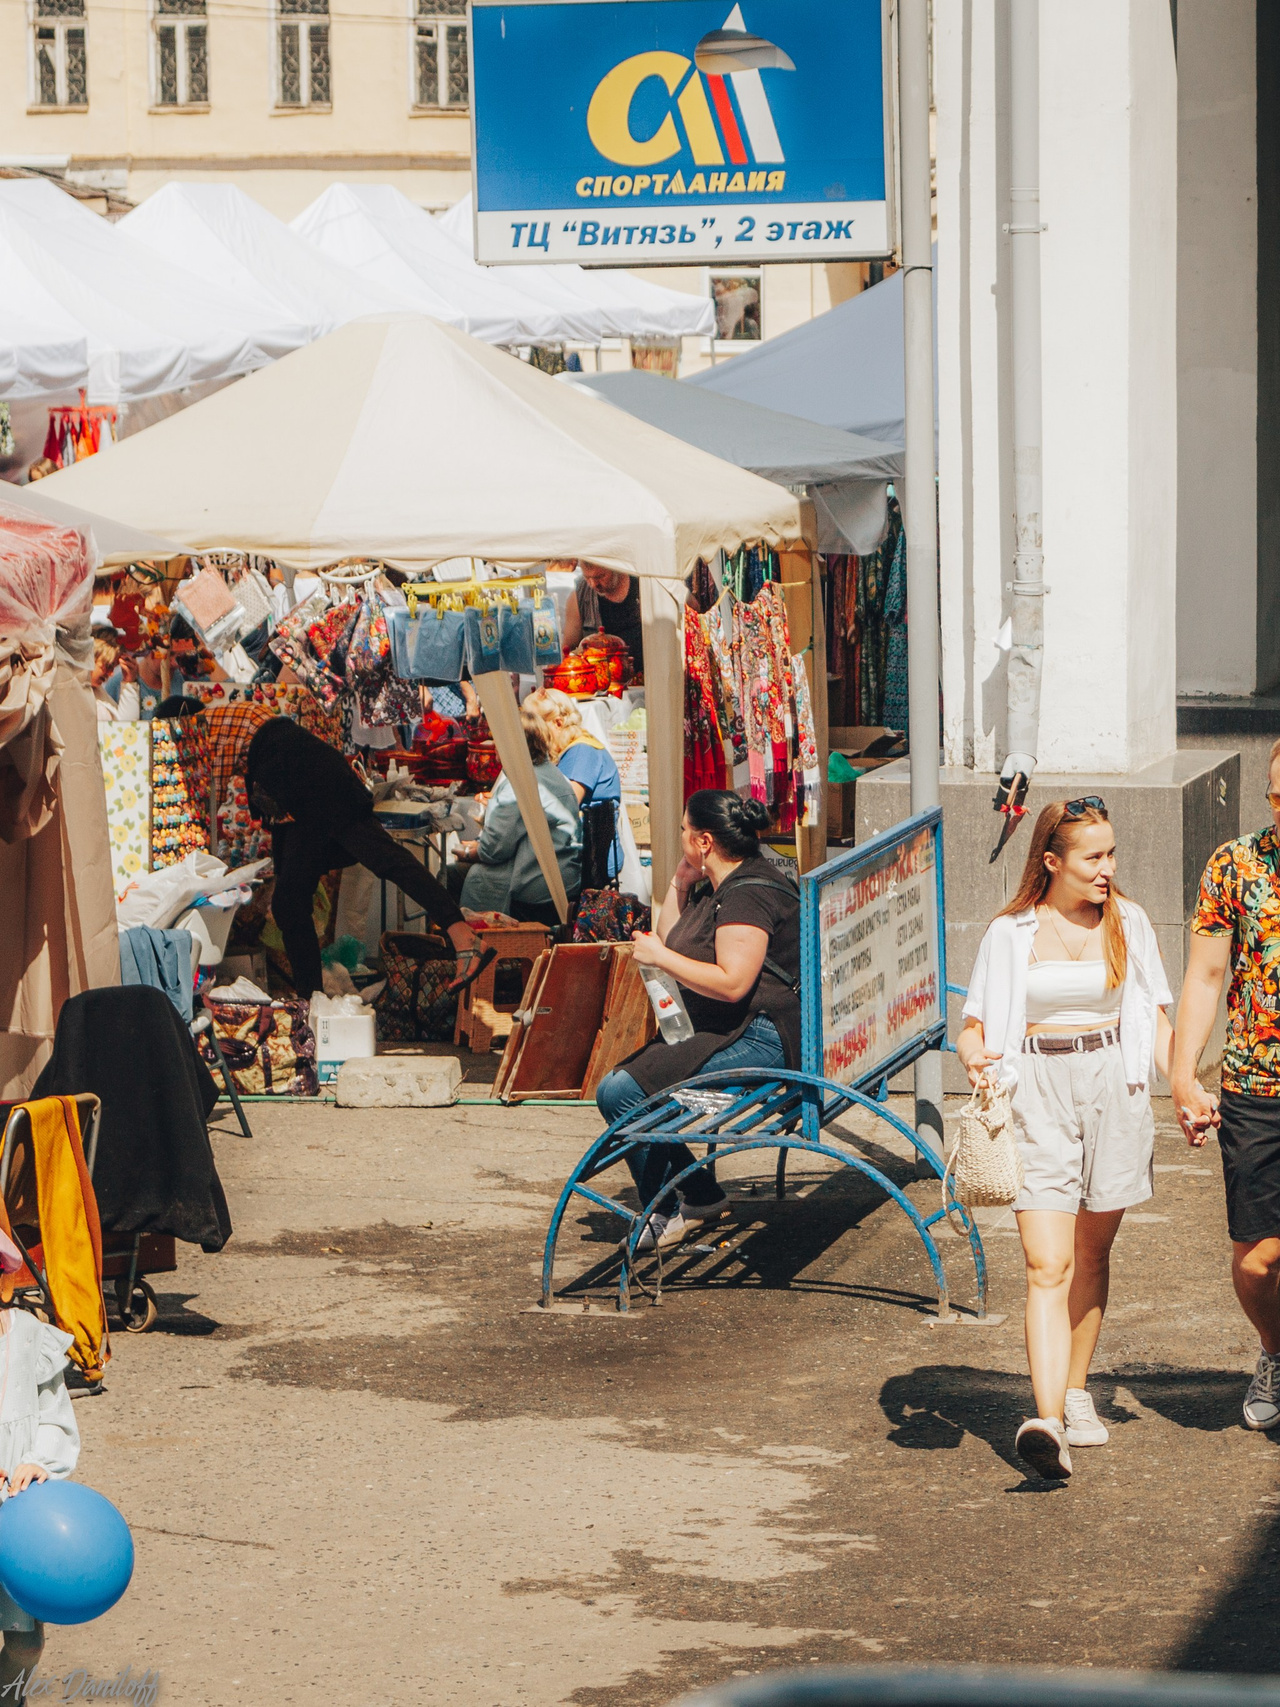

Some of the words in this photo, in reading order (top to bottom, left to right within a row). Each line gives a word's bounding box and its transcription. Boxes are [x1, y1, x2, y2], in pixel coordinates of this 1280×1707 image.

[576, 169, 786, 197] СПОРТЛАНДИЯ
[511, 222, 551, 252] ТЦ
[735, 216, 755, 242] 2
[765, 217, 855, 241] этаж
